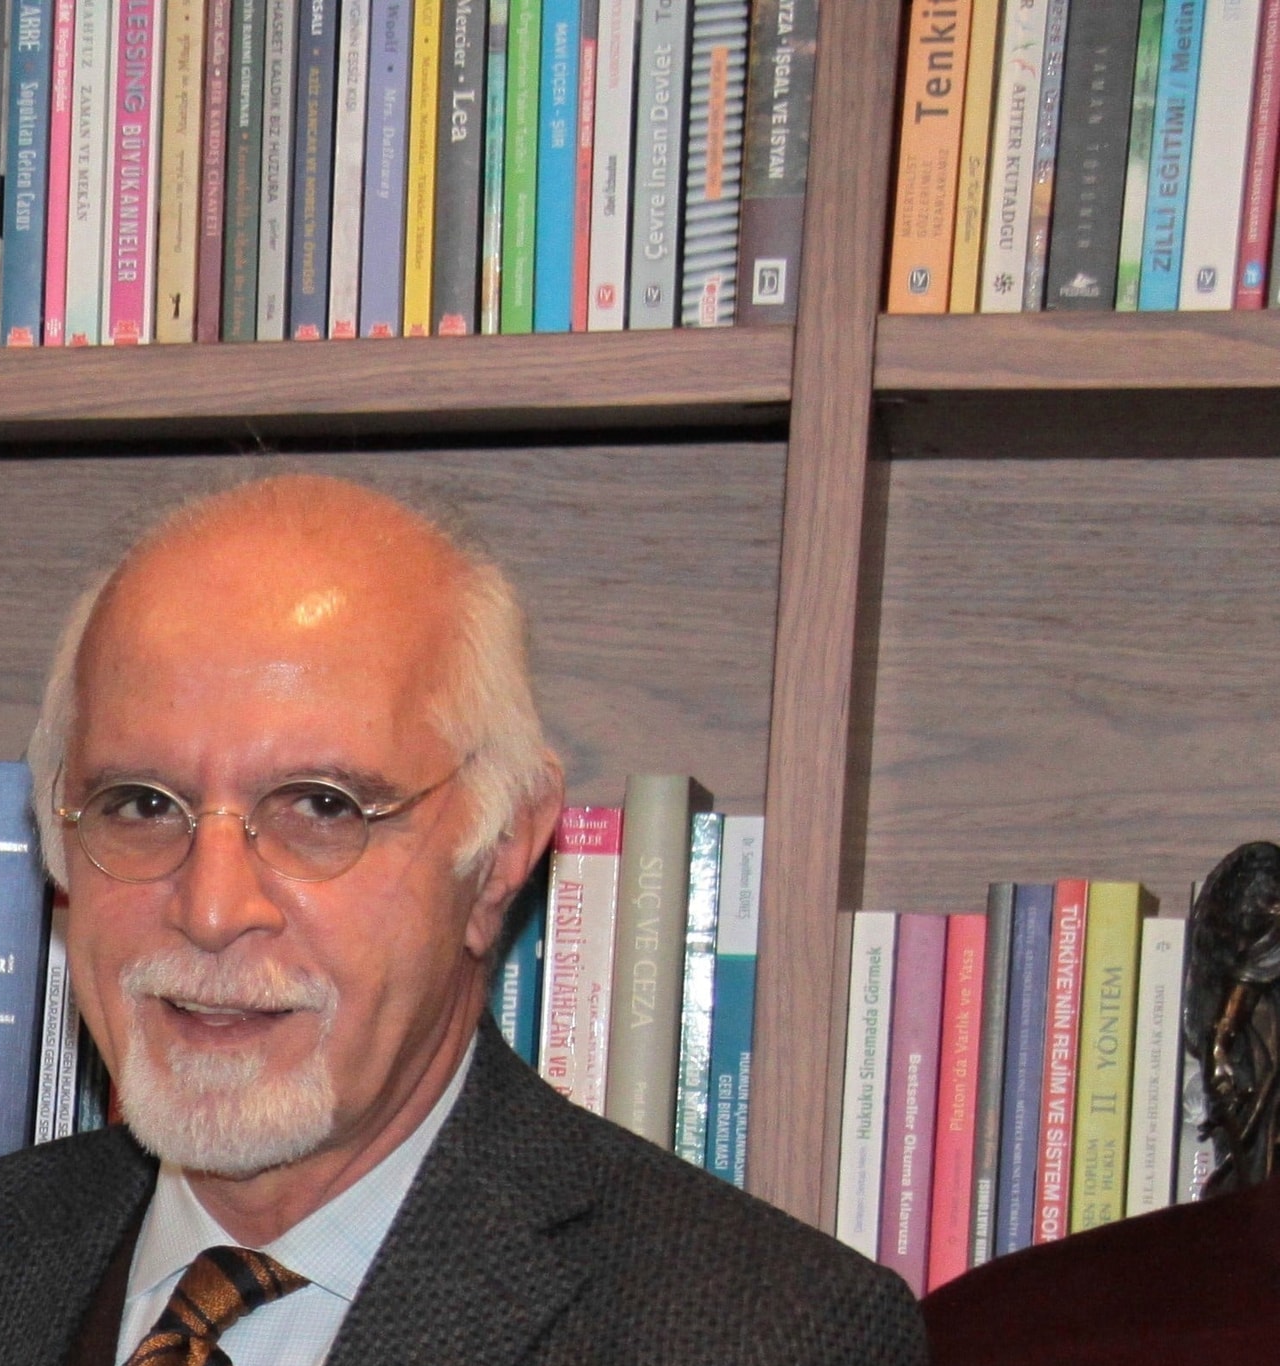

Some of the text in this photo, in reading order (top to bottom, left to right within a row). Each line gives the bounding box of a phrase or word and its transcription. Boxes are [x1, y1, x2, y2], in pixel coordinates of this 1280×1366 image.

[79, 86, 93, 138] ZAMAN
[117, 0, 150, 283] LESSING BÜYÜKANNELER
[450, 89, 477, 145] Lea
[767, 102, 789, 180] VE İSYAN
[15, 150, 37, 188] Gelen
[78, 145, 91, 173] VE
[643, 44, 673, 260] Çevre İnsan Devlet
[998, 82, 1030, 252] AHTER KUTADGU
[14, 193, 36, 232] Casus
[1150, 206, 1176, 273] ZİLLİ
[630, 855, 664, 1030] SUÇ VE CEZA
[861, 945, 884, 1006] Görmek
[959, 948, 975, 981] Yasa
[959, 988, 972, 1006] ve
[1094, 966, 1124, 1071] YÖNTEM
[40, 966, 62, 1119] ULUSLARARASI GEN HUKUKU
[548, 1056, 565, 1078] ve
[857, 1008, 879, 1080] Sinemada
[954, 1012, 970, 1054] Varlık
[1042, 904, 1080, 1202] TÜRKİYE'NİN REJİM VE SİSTEM
[59, 1051, 76, 1120] GEN HUKUKU
[854, 1084, 876, 1140] Hukuku
[949, 1059, 969, 1132] Platon'da
[1089, 1092, 1118, 1116] II
[714, 1073, 736, 1170] GERİ BIRAKILMASI
[897, 1053, 922, 1255] Bestseller Okuma Kılavuzu
